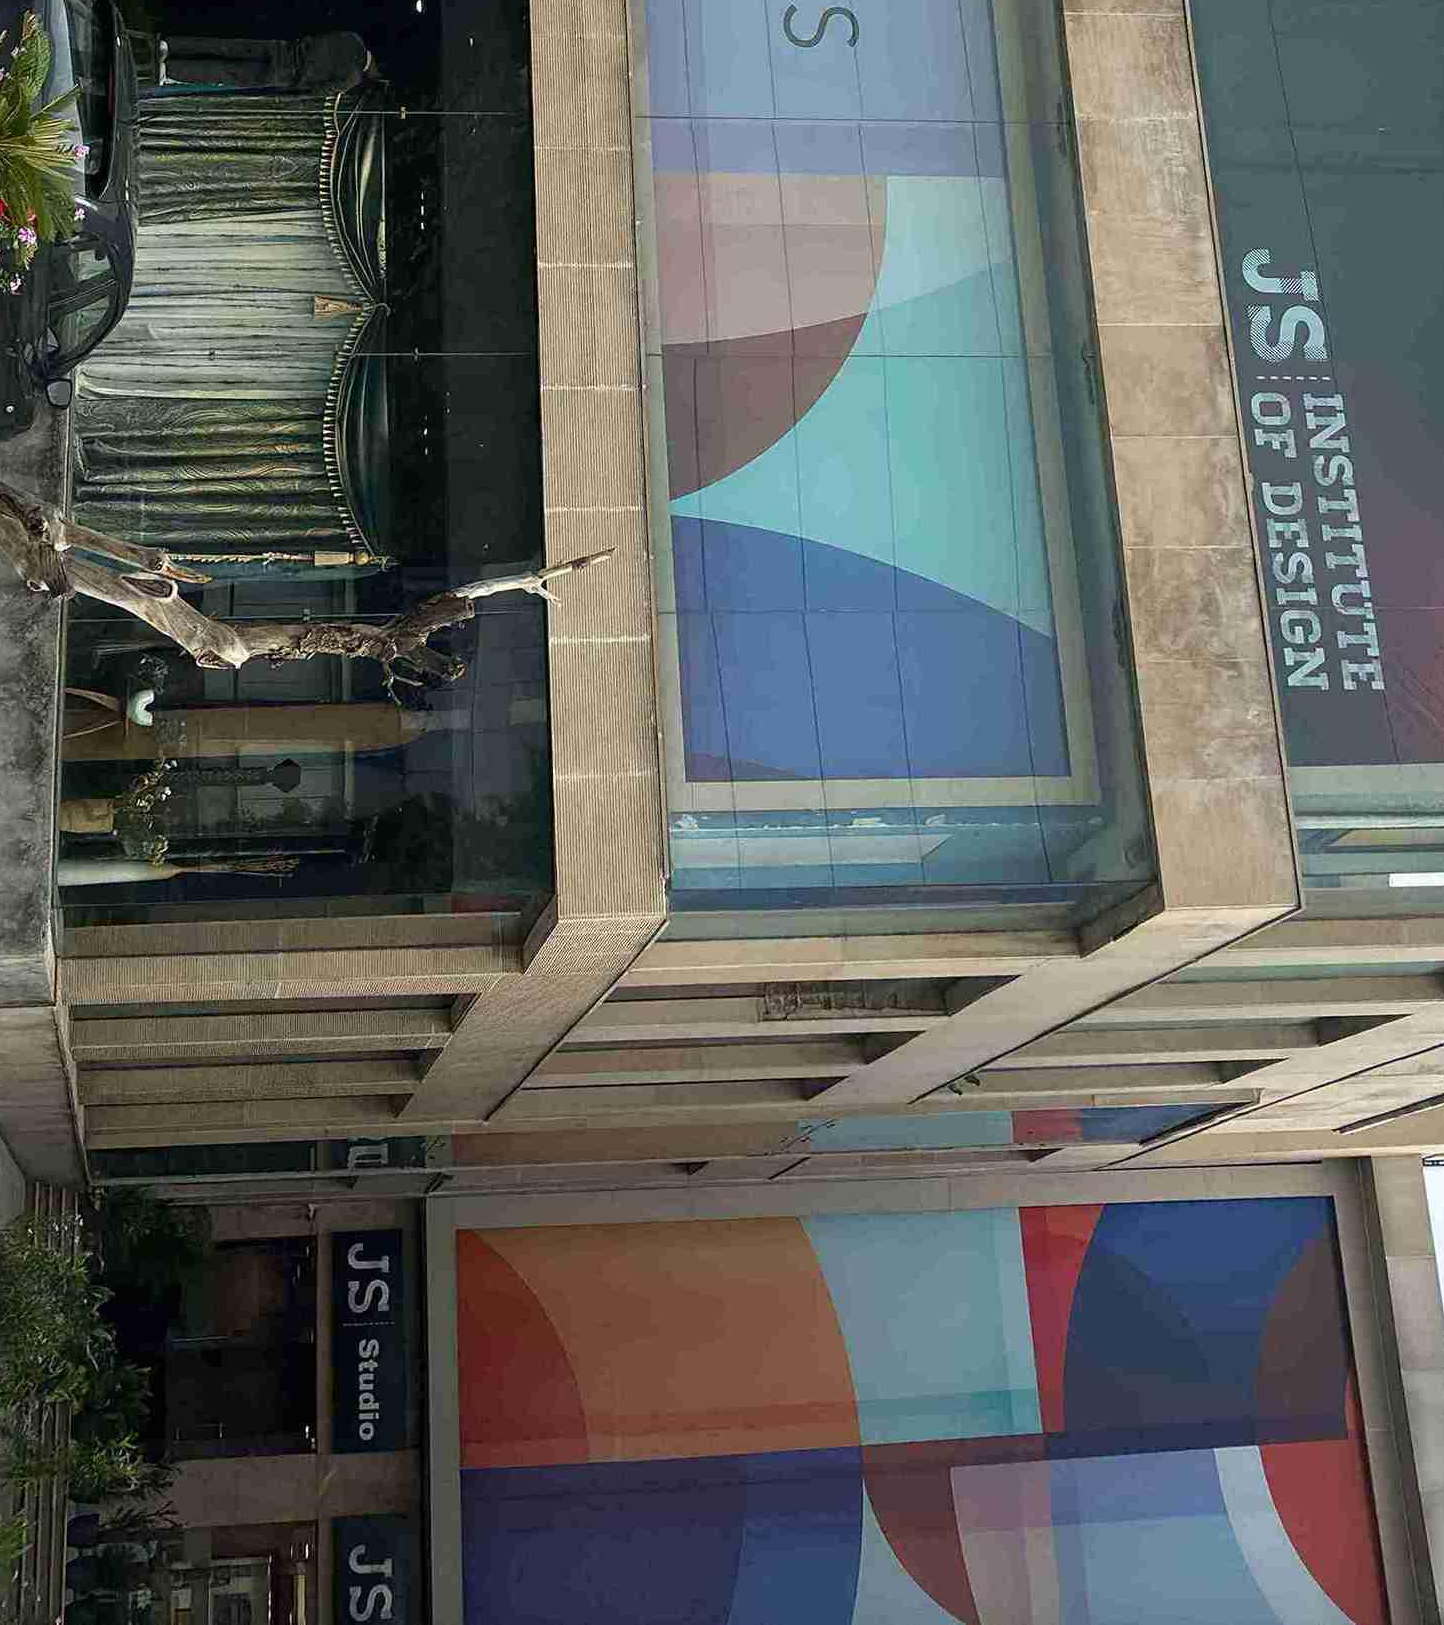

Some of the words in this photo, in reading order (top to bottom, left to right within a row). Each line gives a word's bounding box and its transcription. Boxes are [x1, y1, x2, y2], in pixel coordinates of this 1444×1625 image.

[1241, 248, 1329, 363] JS
[1250, 391, 1296, 459] OF
[1260, 482, 1329, 691] DESIGN
[1303, 392, 1385, 692] INSTITUTE
[346, 1243, 390, 1314] JS
[357, 1338, 380, 1441] Studio
[348, 1544, 393, 1622] JS
